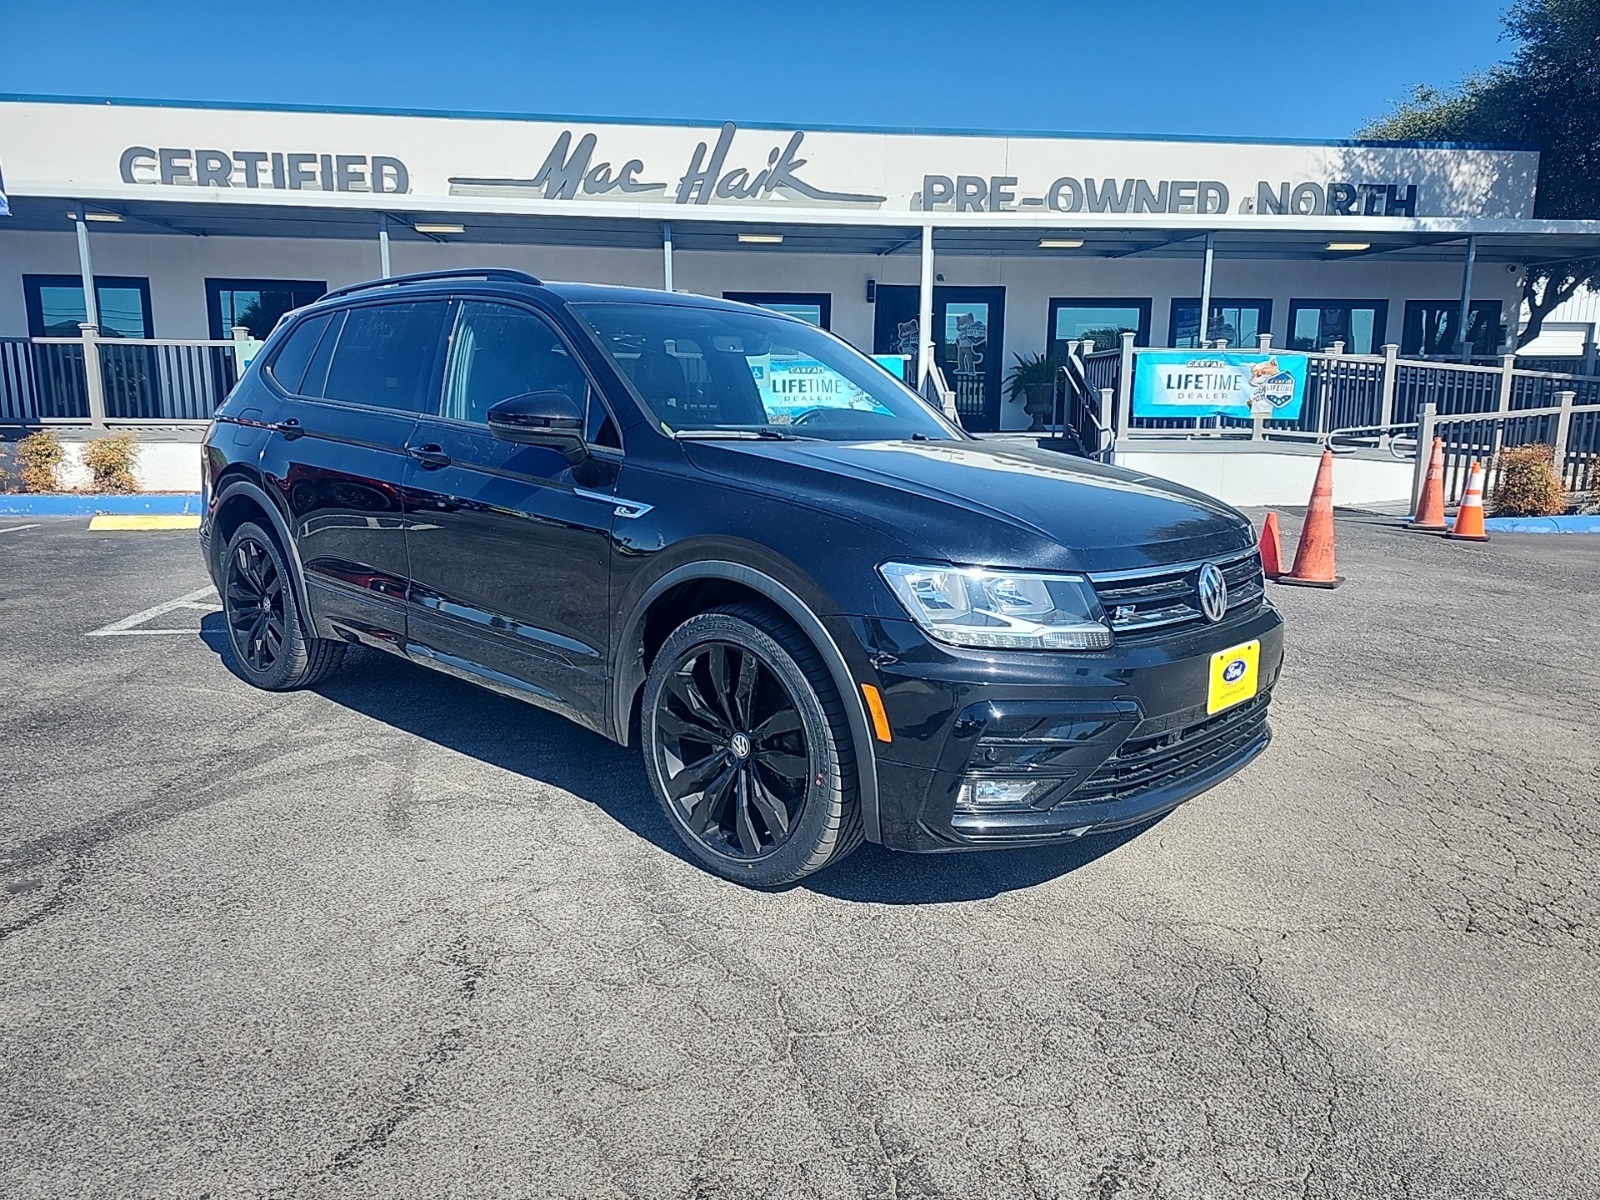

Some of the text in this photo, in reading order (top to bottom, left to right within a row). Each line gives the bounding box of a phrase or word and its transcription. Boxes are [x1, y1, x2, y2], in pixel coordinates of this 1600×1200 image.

[119, 146, 411, 195] CERTIFIED
[448, 121, 888, 205] Mac Haik
[922, 174, 1418, 218] PRE-OWNED NORTH
[772, 379, 842, 393] LIFETIME
[1166, 374, 1242, 391] LIFETIME
[1178, 392, 1228, 400] DEALER
